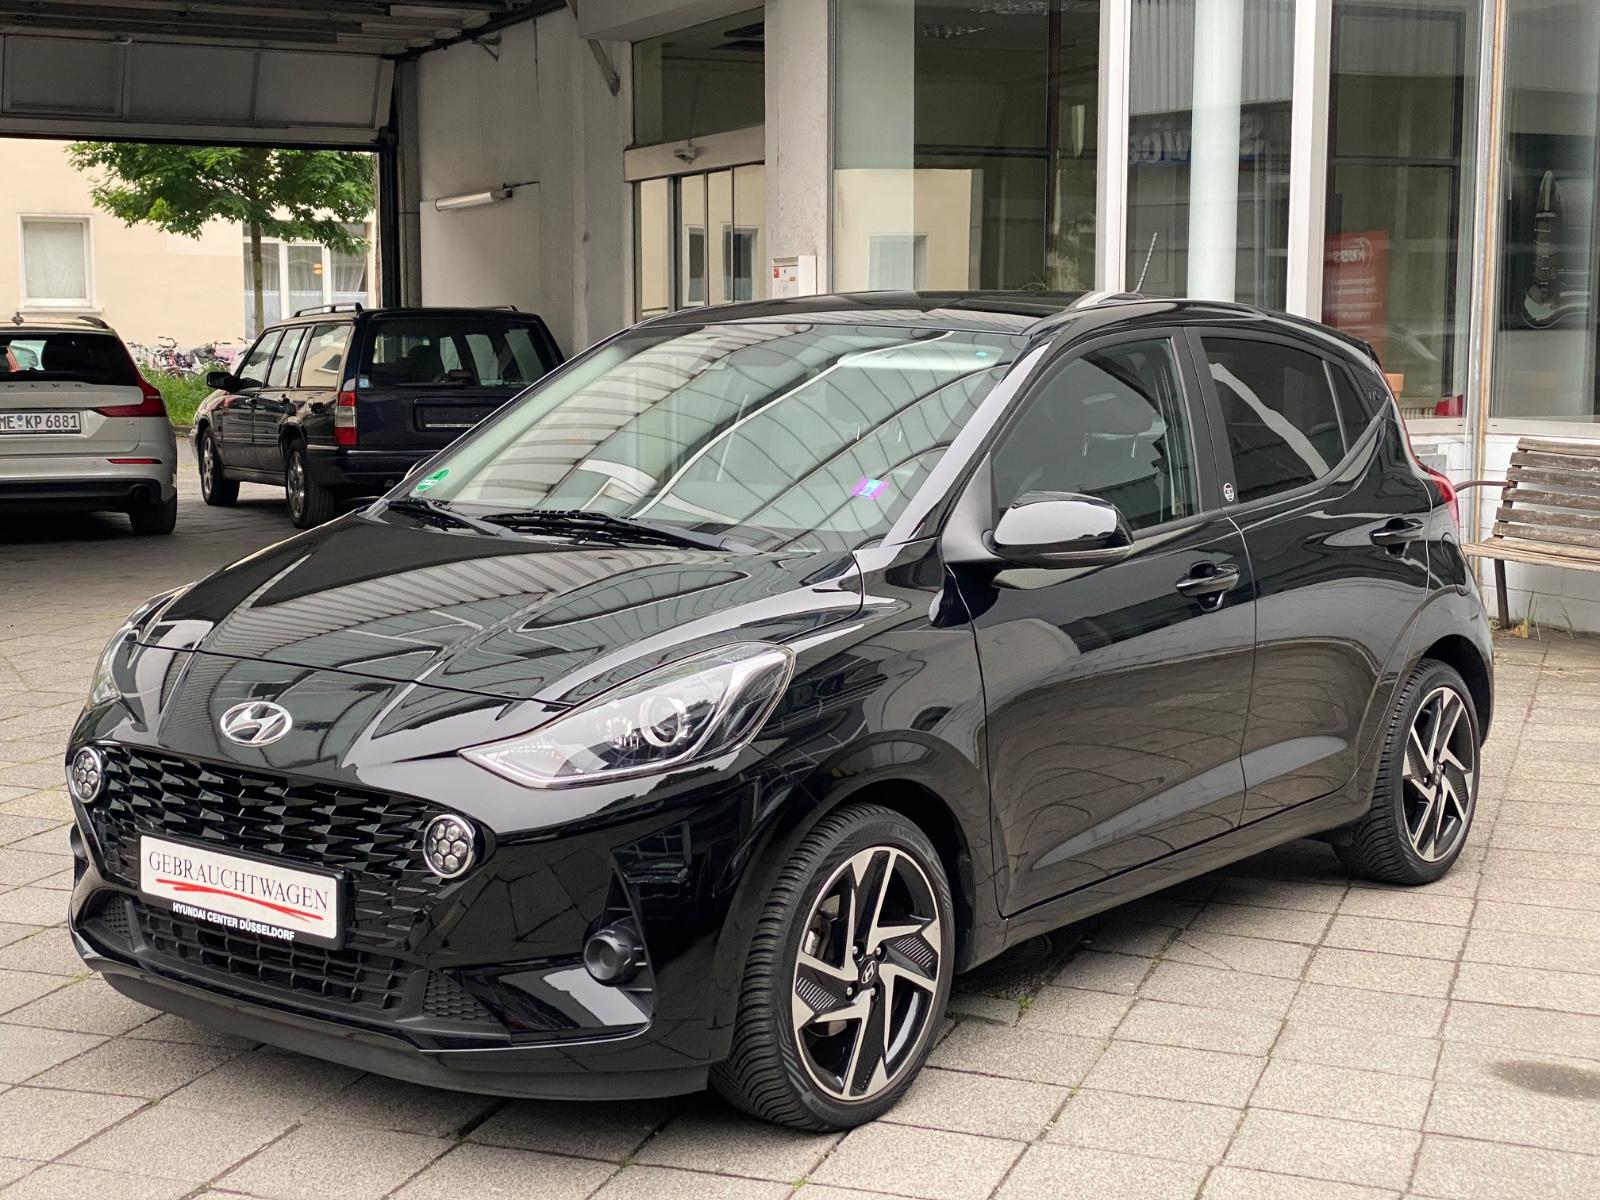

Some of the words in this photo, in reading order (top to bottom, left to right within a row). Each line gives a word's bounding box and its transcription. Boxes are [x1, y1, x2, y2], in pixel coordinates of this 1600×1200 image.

[25, 415, 42, 429] KP
[45, 415, 78, 429] 6881
[149, 851, 328, 911] GEBRAUCHTWAGEN
[172, 902, 206, 920] HYUNDAI
[207, 911, 238, 929] CENTER
[239, 918, 295, 941] DÜSSELDORF
